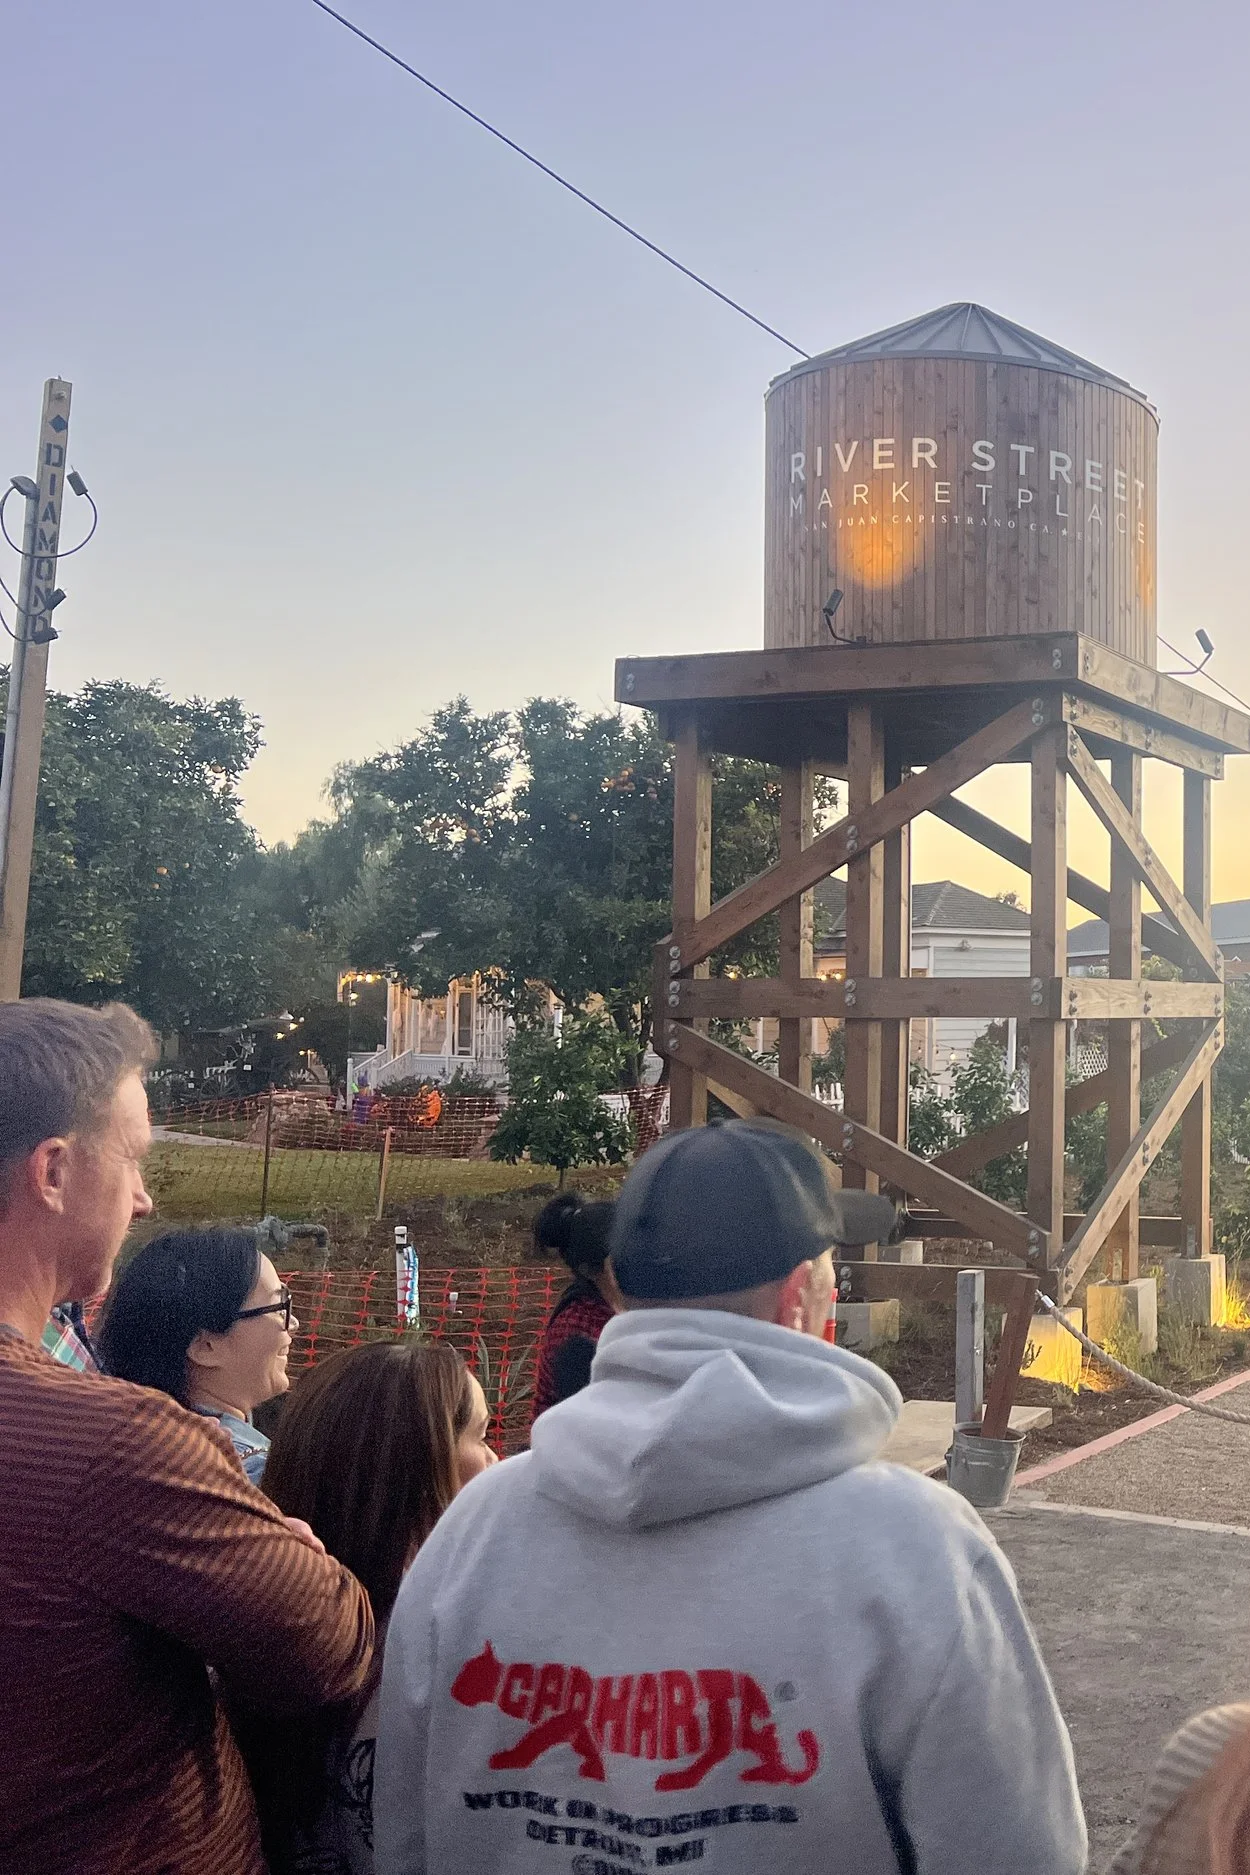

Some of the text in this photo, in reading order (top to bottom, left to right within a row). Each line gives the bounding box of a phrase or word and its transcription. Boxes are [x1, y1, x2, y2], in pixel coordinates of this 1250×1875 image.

[790, 437, 1146, 509] RIVER STREET
[31, 443, 64, 637] DIAMOND
[789, 480, 1146, 545] MARKETPLACE
[838, 514, 878, 529] JUAN
[891, 513, 1017, 530] CAPISTRANO
[463, 1790, 559, 1816] WORK
